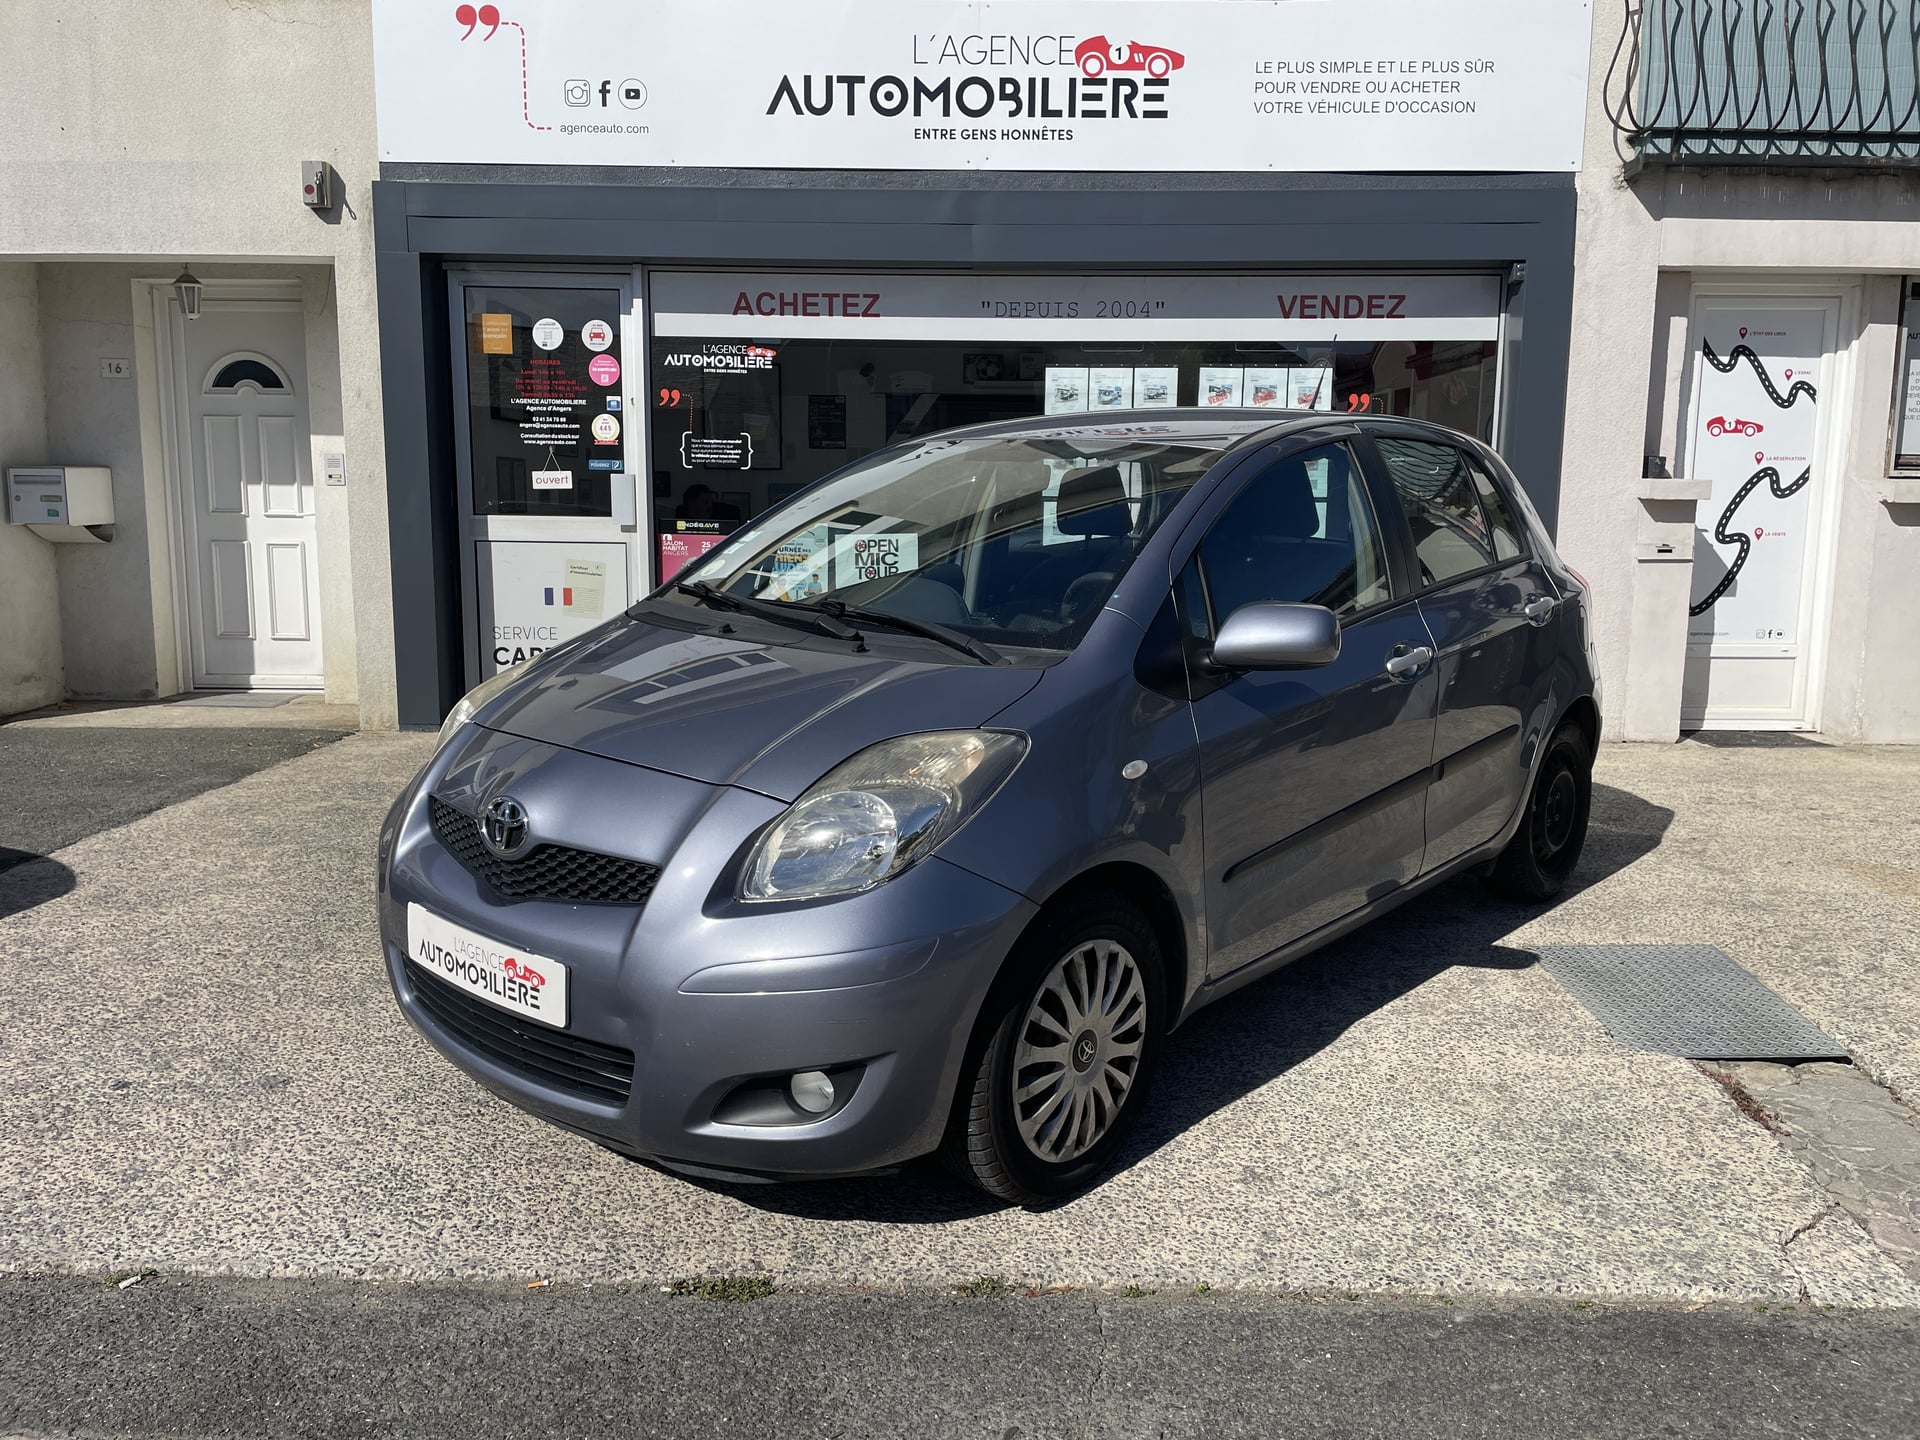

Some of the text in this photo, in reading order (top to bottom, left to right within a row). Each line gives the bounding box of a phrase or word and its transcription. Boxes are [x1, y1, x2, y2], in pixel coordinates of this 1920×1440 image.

[914, 34, 1075, 66] L'AGENCE
[1255, 58, 1496, 74] LE PLUS SIMPLE ET LE PLUS SÛR
[1254, 80, 1461, 94] POUR VENDRE OU ACHETER
[766, 73, 1169, 119] AUTOMOBILIERE
[1253, 99, 1476, 114] VOTRE VÉHICULE D'OCCASION
[560, 123, 650, 136] agenceauto.com
[914, 125, 1074, 141] ENTRE GENS HONNÊTES
[732, 291, 881, 318] ACHETEZ
[1277, 294, 1406, 319] VENDEZ
[703, 344, 747, 354] L'AGENCE
[109, 363, 122, 374] 16
[535, 475, 569, 485] ouvert
[855, 538, 899, 553] OPEN
[855, 552, 899, 566] MIC
[855, 566, 899, 580] TOUR
[492, 625, 558, 641] SERVICE
[454, 936, 505, 972] L'AGENCE
[419, 938, 541, 1010] AUTOMOBILIERE
